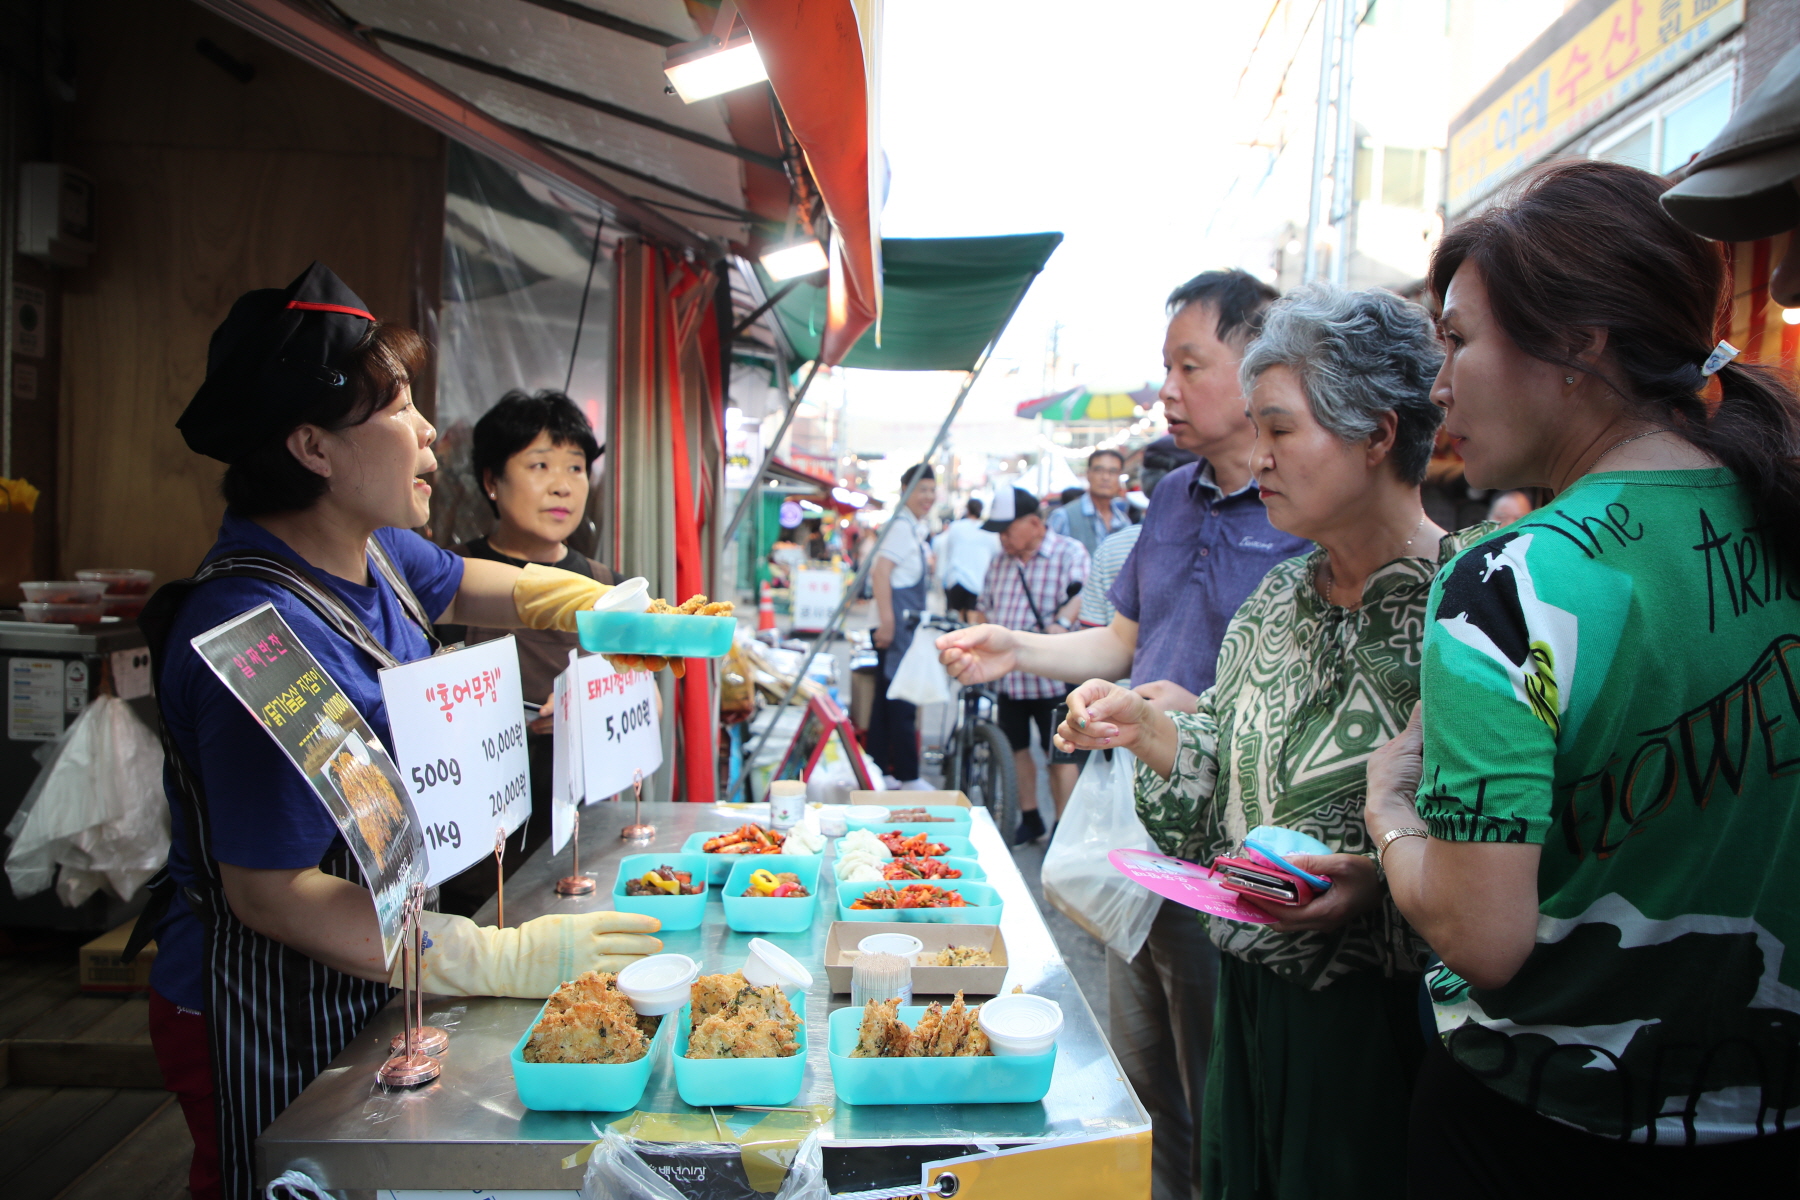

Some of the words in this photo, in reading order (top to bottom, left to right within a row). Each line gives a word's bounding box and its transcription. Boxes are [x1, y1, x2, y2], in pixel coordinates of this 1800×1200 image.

[296, 667, 327, 697] 지짐이
[605, 698, 651, 743] 5,000원
[411, 758, 462, 794] 500g
[481, 721, 523, 762] 10,000원
[425, 820, 462, 850] 1kg
[488, 770, 527, 817] 20,000원
